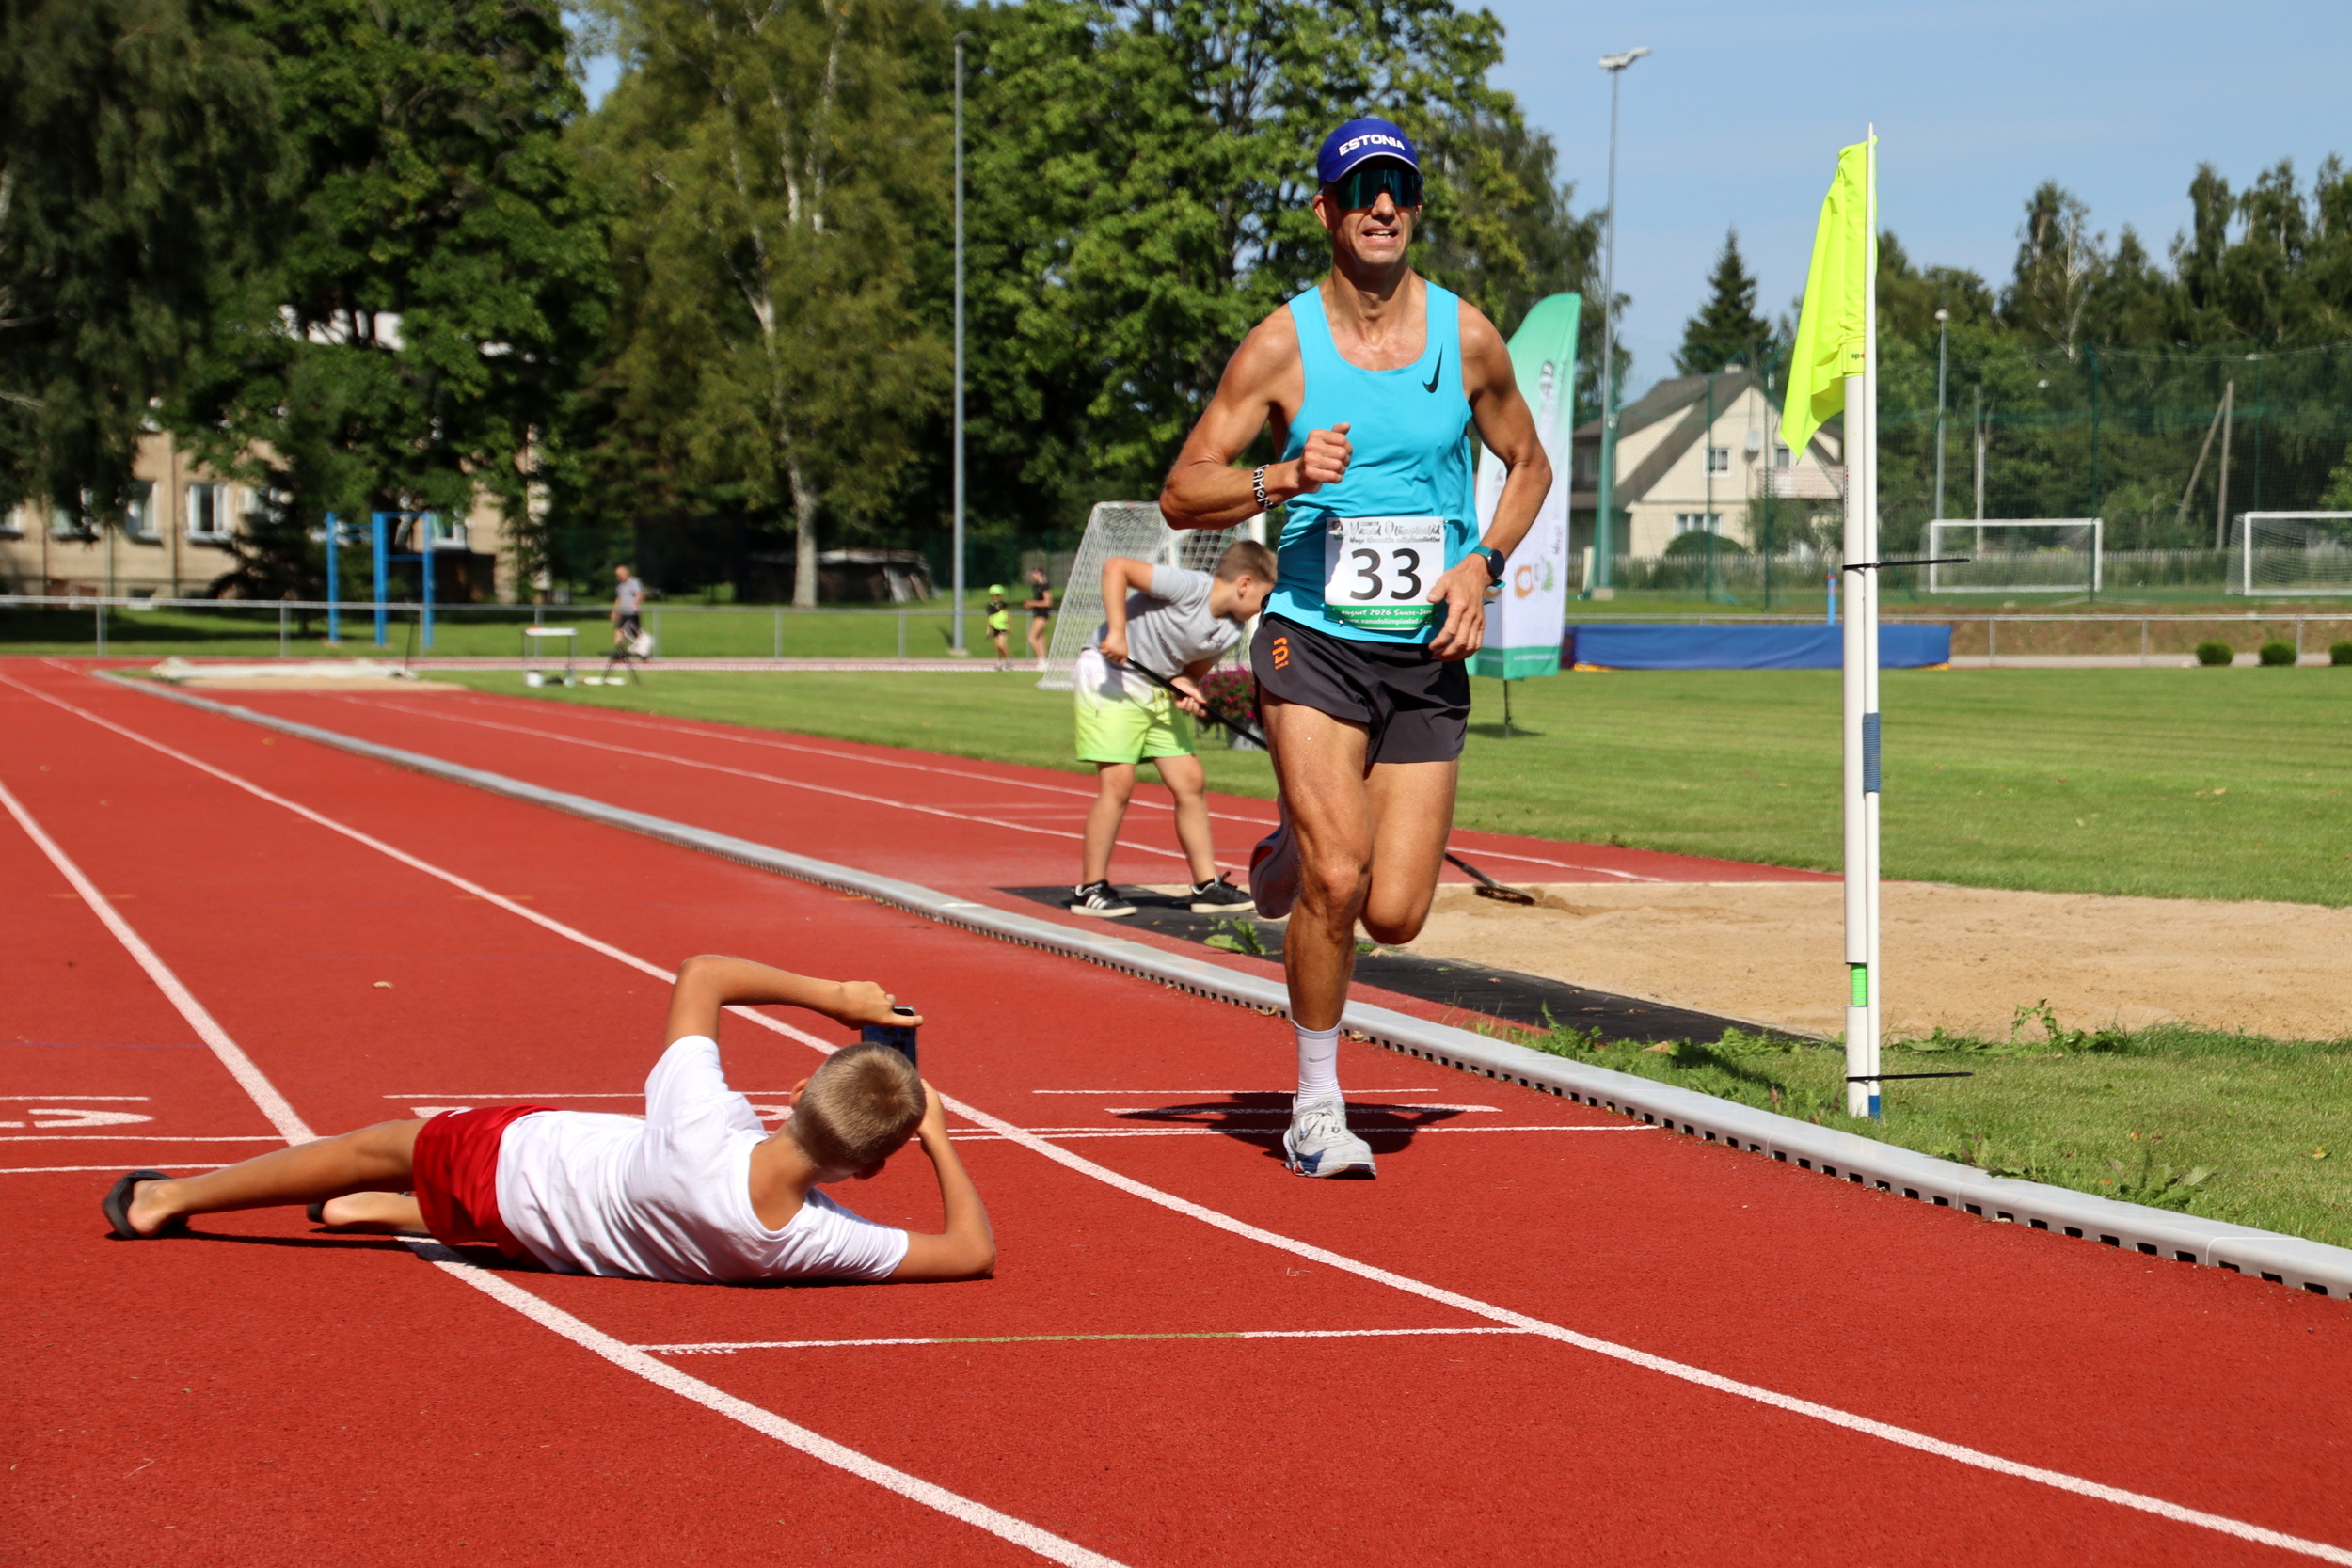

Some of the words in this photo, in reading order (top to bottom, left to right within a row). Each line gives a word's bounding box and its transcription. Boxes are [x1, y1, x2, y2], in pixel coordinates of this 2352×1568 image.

[1339, 134, 1405, 156] ESTONIA
[1349, 547, 1422, 601] 33
[1369, 608, 1392, 616] 2026
